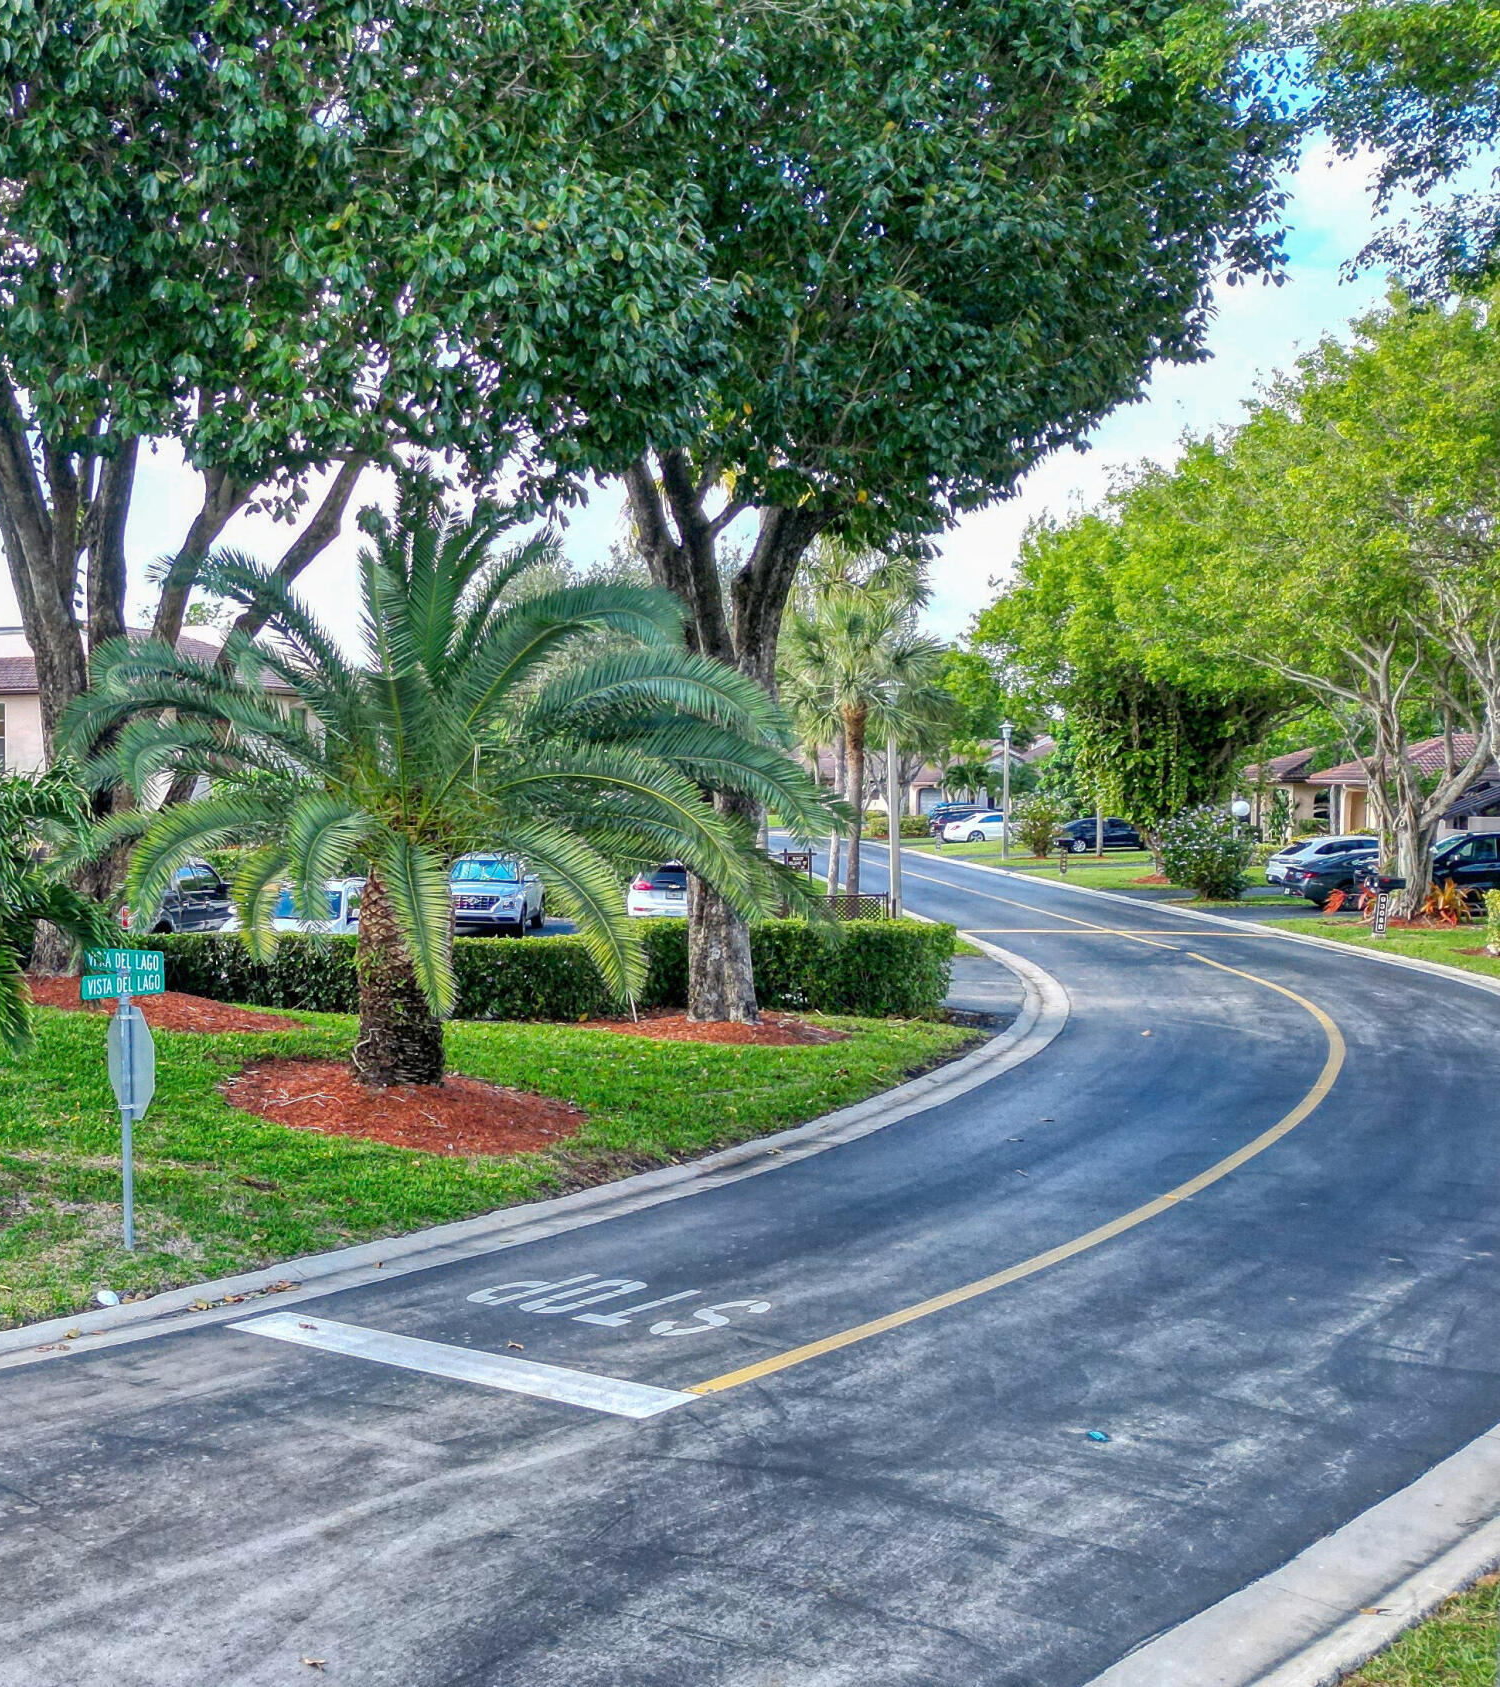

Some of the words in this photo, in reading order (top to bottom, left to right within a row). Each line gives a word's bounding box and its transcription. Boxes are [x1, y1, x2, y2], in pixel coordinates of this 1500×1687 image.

[115, 952, 132, 970] DEL
[135, 954, 159, 972] LAGO
[87, 977, 113, 996] VISTA
[116, 976, 133, 993] DEL
[137, 974, 160, 992] LAGO
[466, 1273, 772, 1336] STOP
